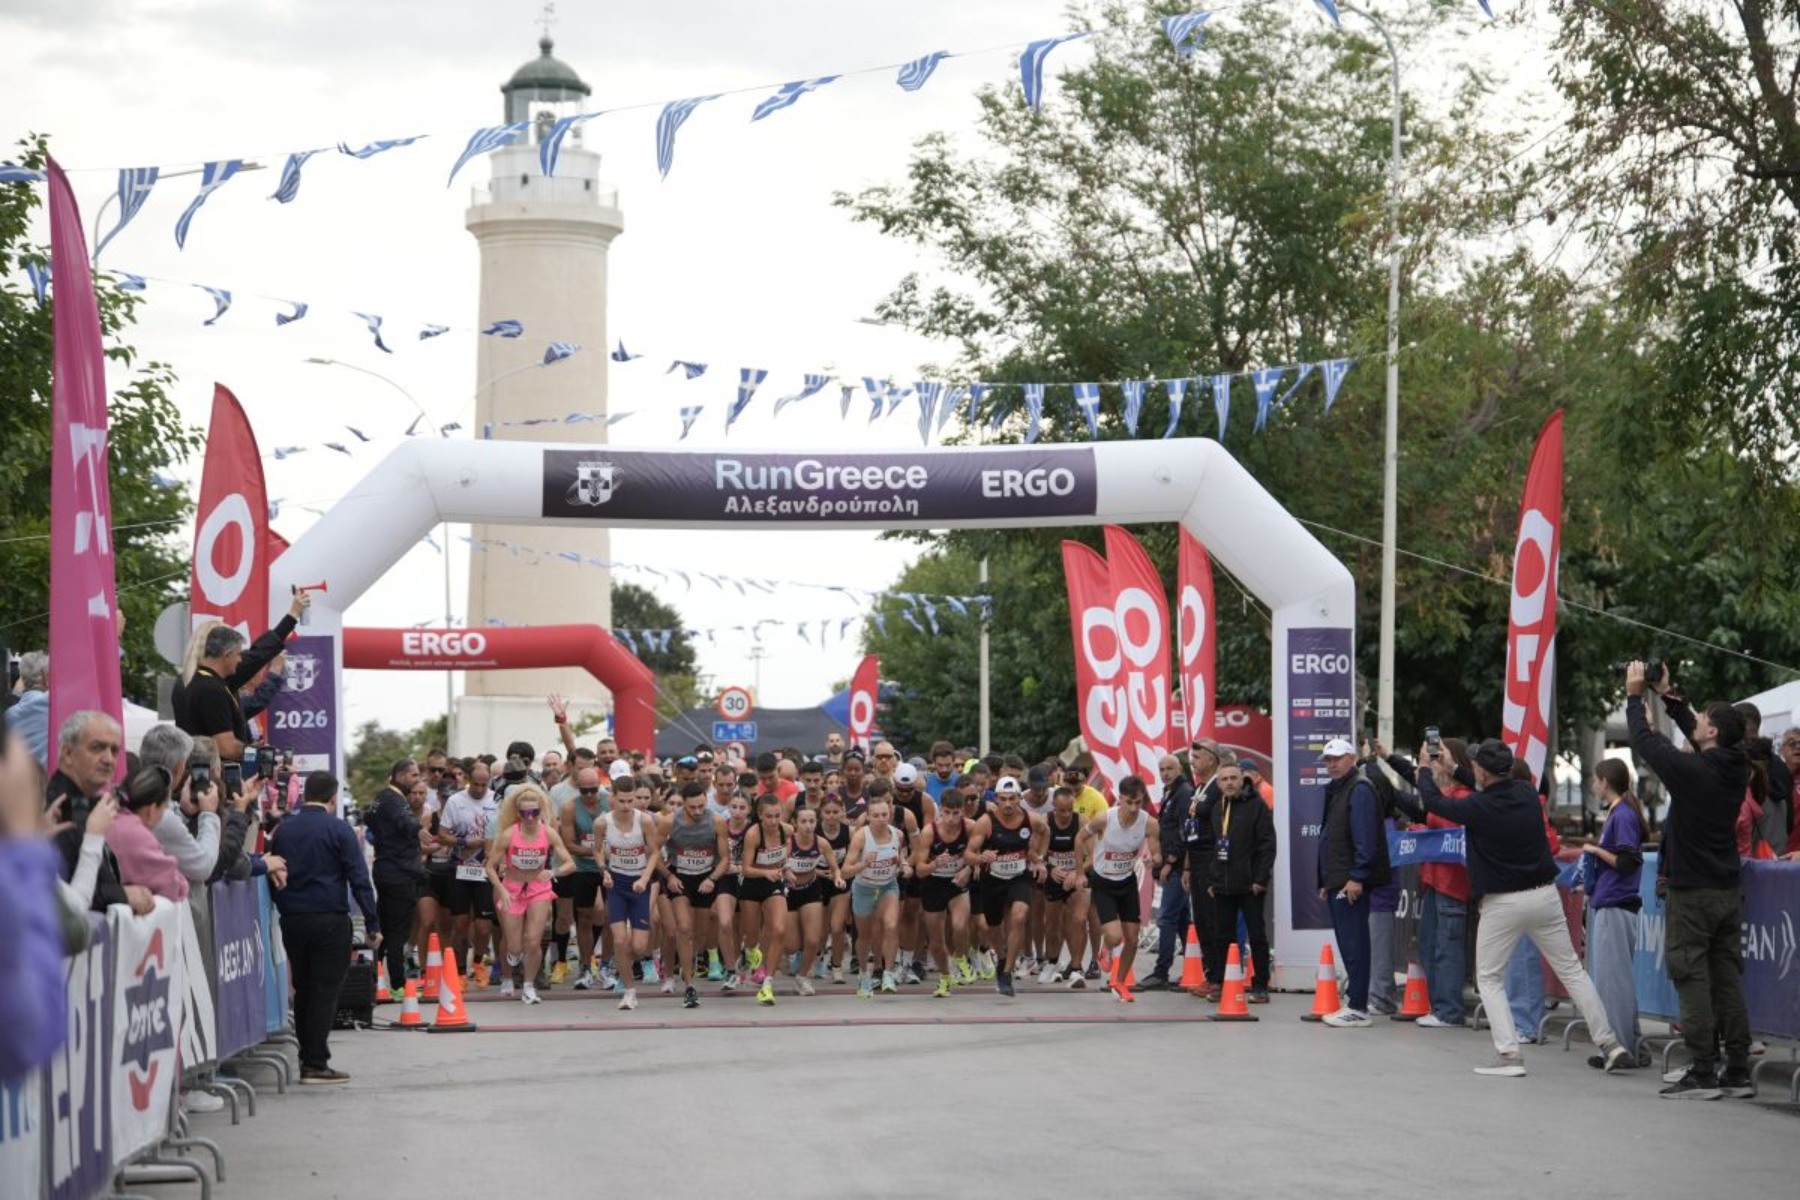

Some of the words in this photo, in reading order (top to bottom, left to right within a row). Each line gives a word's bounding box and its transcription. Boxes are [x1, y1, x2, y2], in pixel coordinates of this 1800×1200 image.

[715, 459, 928, 490] RunGreece
[981, 468, 1075, 498] ERGO
[724, 494, 919, 517] Αλεξανδρούπολη
[402, 631, 486, 656] ERGO
[1291, 654, 1350, 674] ERGO
[725, 697, 745, 710] 30
[275, 710, 328, 729] 2026
